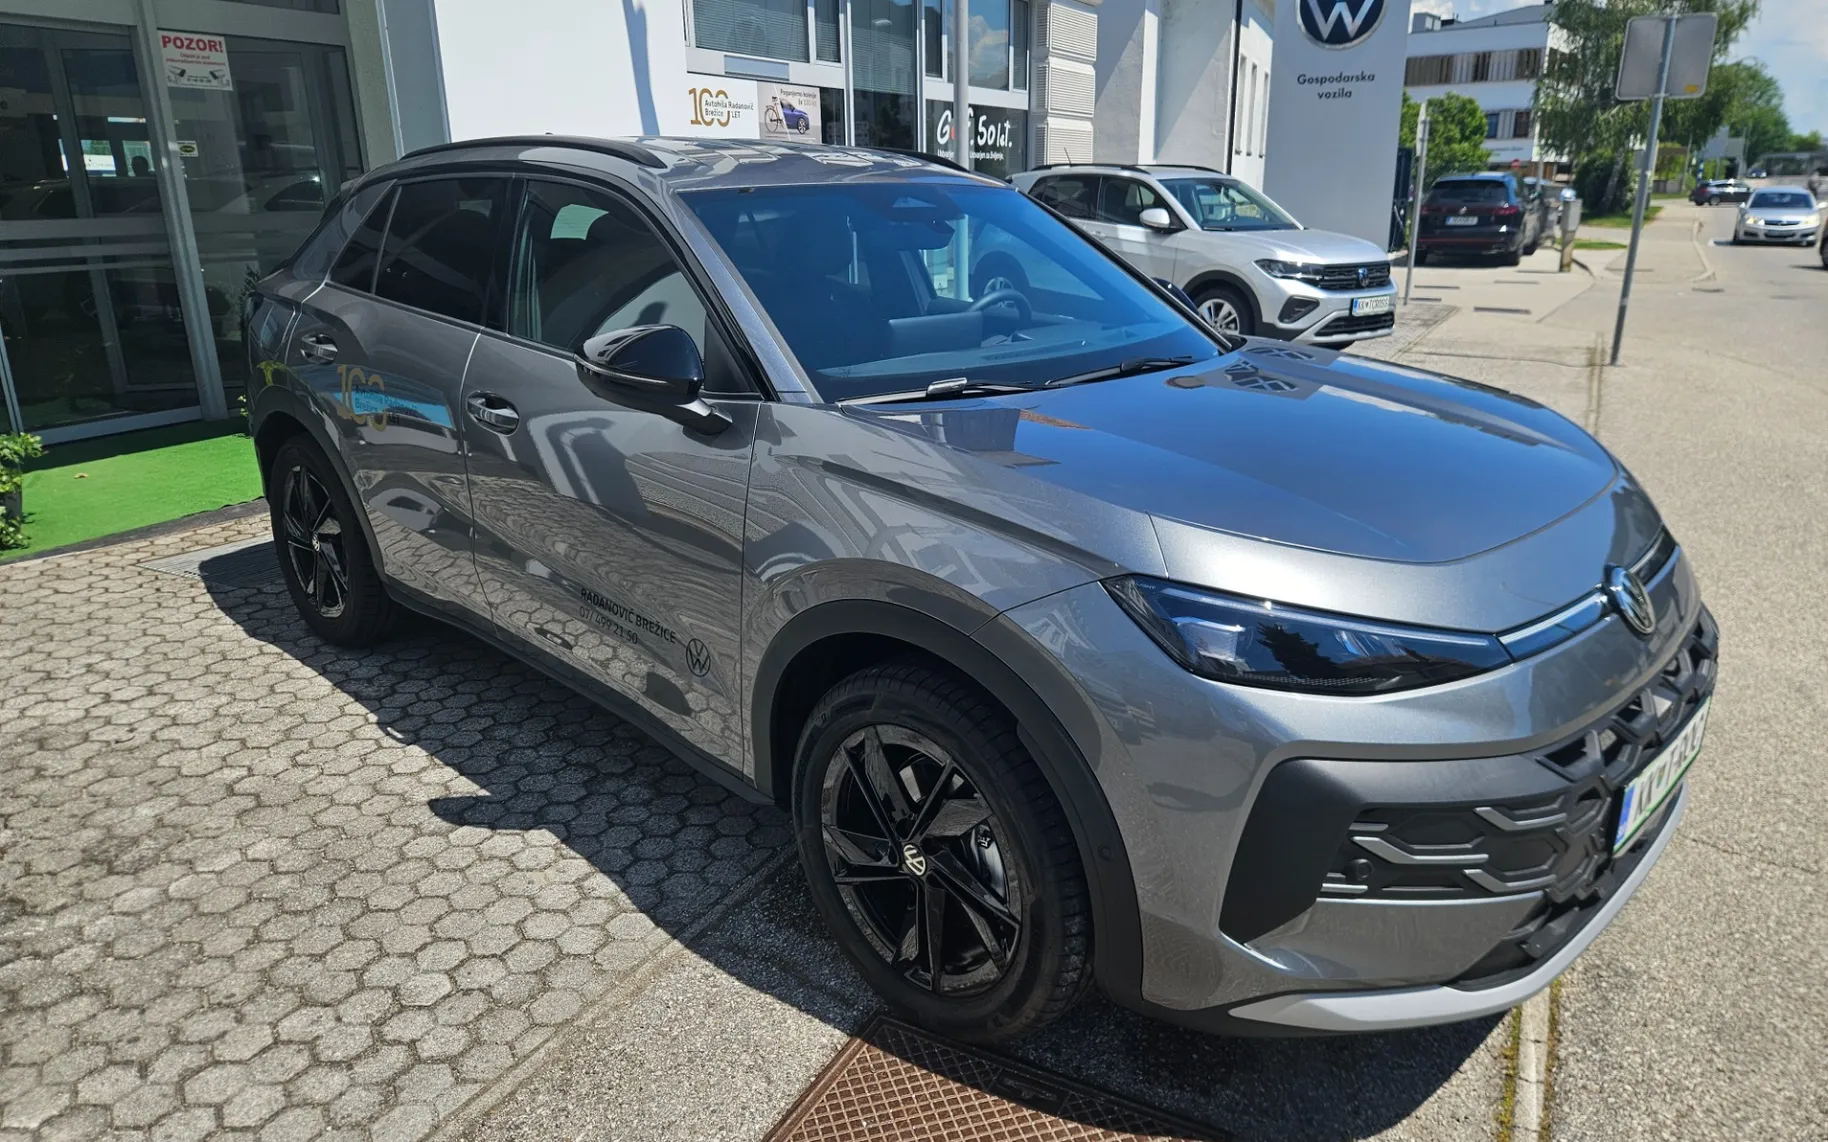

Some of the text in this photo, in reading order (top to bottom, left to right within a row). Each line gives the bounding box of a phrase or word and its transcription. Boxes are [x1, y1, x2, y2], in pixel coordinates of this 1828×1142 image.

[161, 35, 224, 53] POZOR!
[1297, 70, 1376, 86] Gospodarska
[1317, 87, 1353, 99] vozila
[688, 87, 731, 127] 100
[635, 613, 677, 644] BREŽICE
